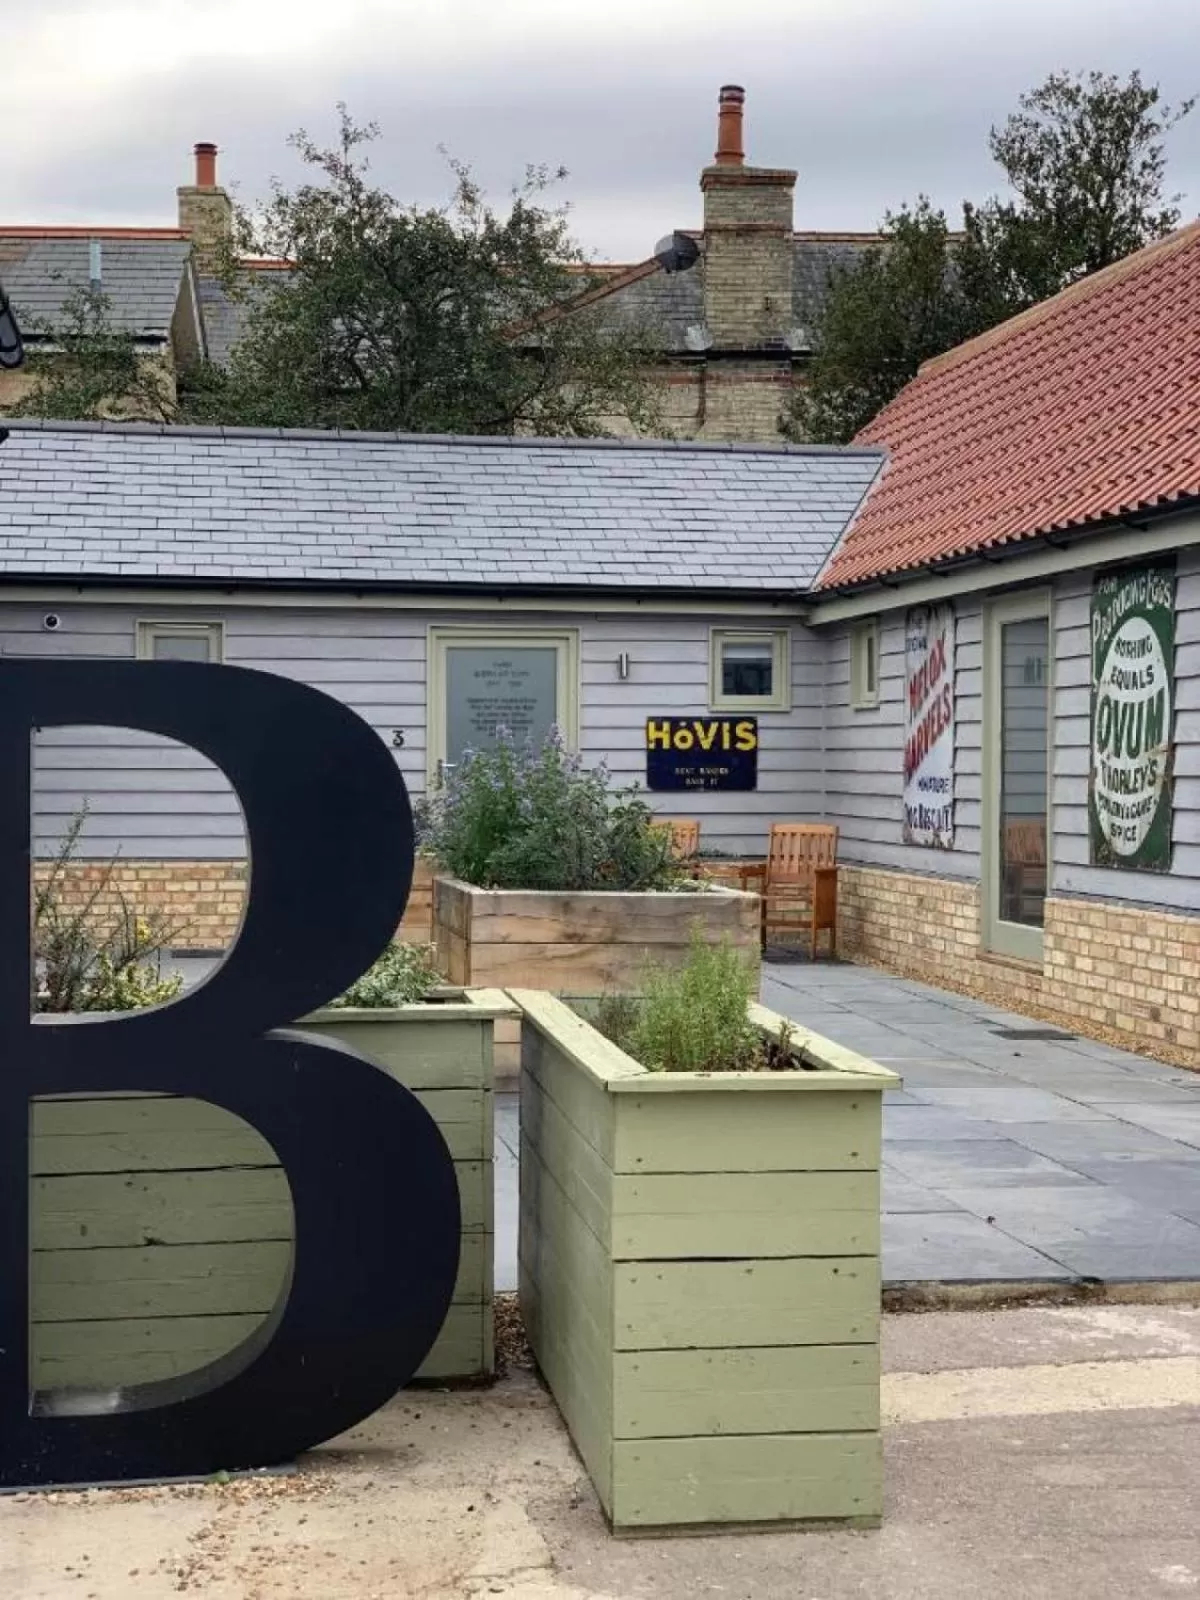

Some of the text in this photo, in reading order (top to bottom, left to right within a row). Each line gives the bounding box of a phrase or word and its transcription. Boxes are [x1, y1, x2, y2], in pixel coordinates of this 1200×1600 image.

[1113, 634, 1153, 659] NOTHING
[908, 630, 948, 725] MELOX
[1110, 664, 1155, 691] EQUALS
[1097, 686, 1165, 760] OVUM
[392, 729, 405, 748] 3
[1110, 822, 1138, 843] SPICE
